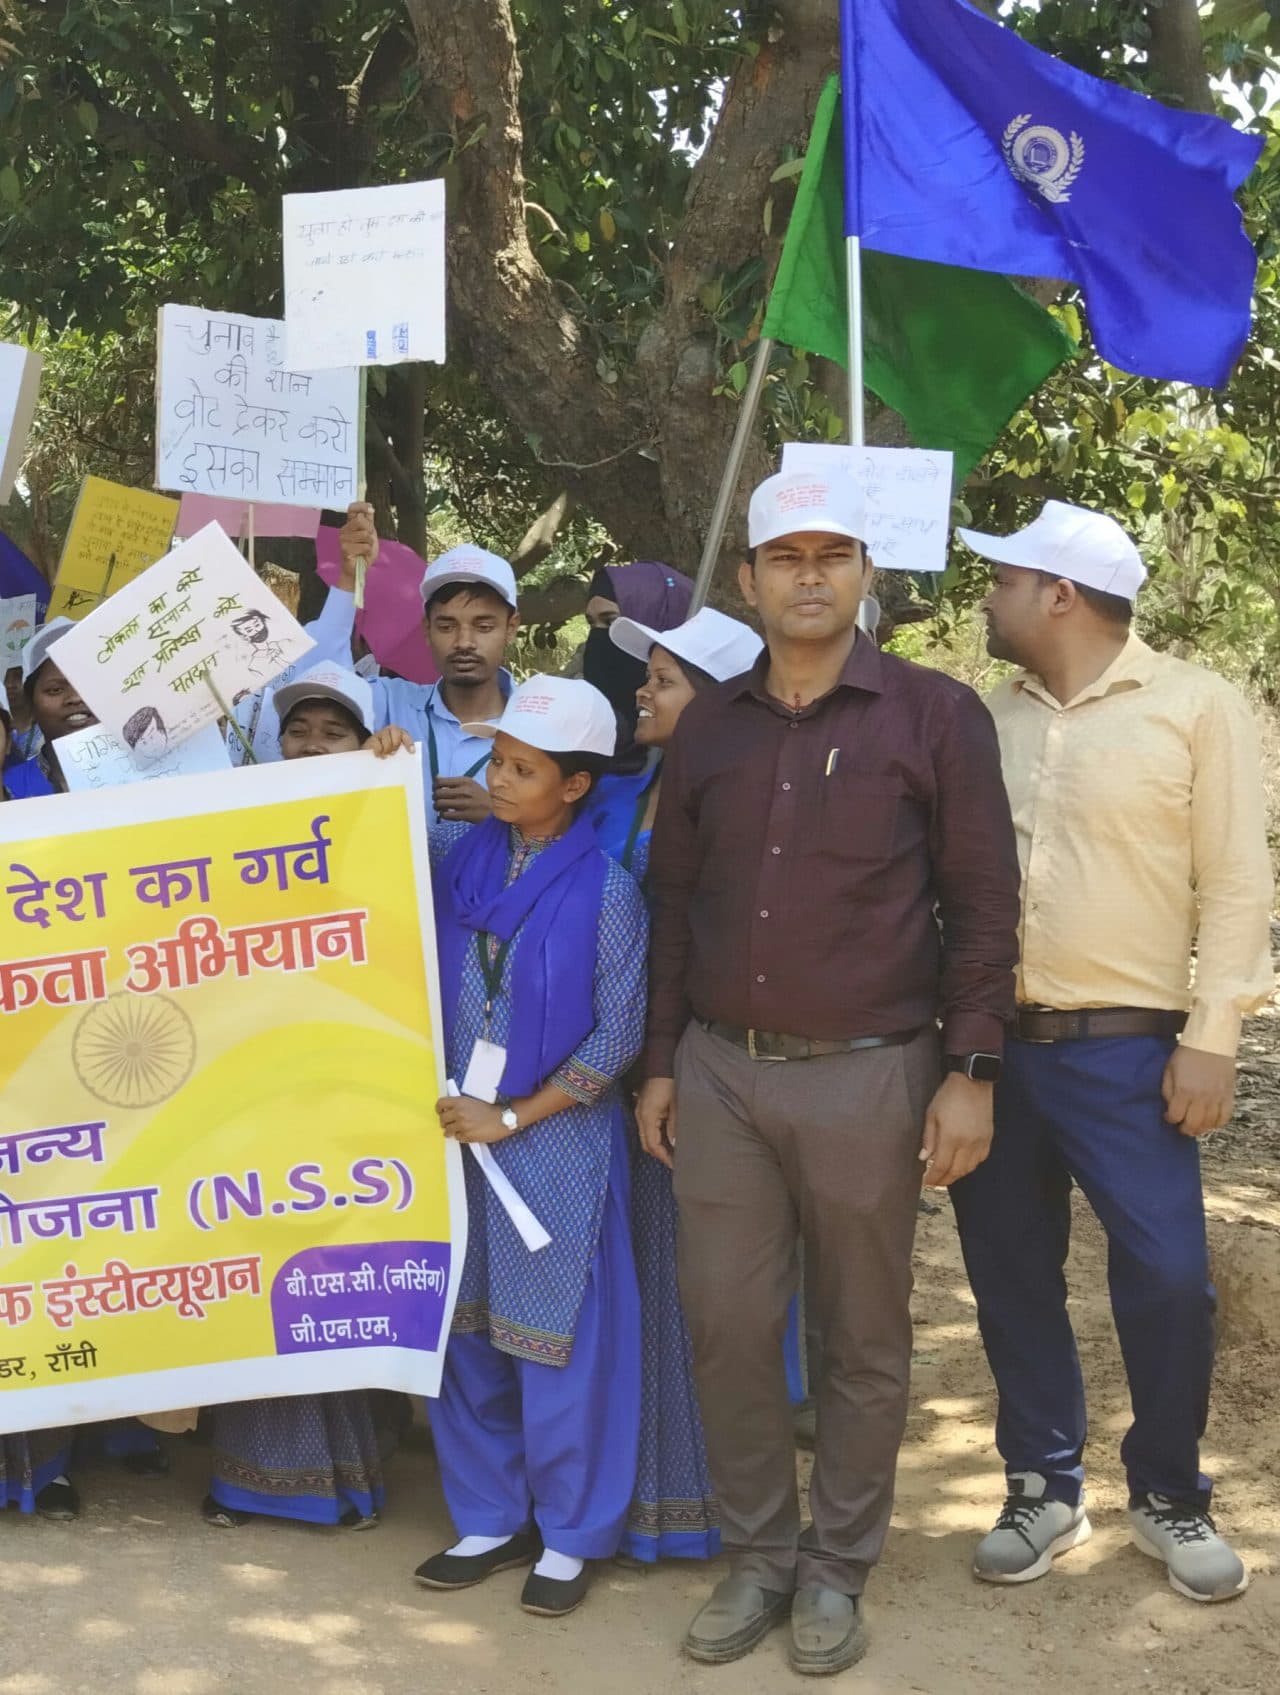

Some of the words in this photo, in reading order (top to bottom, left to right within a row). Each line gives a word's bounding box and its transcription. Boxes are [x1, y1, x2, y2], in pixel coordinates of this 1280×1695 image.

[175, 320, 254, 355] चुनाव
[214, 354, 248, 394] की
[265, 370, 313, 396] शान
[174, 377, 222, 428] वोट
[298, 405, 352, 453] करो
[179, 442, 260, 491] इसका
[148, 592, 168, 615] का
[6, 863, 107, 930] देश
[128, 857, 212, 909] का
[233, 815, 332, 892] गर्व
[125, 911, 367, 994] अभियान
[188, 1157, 414, 1230] (N.S.S)
[45, 1340, 98, 1373] राँची
